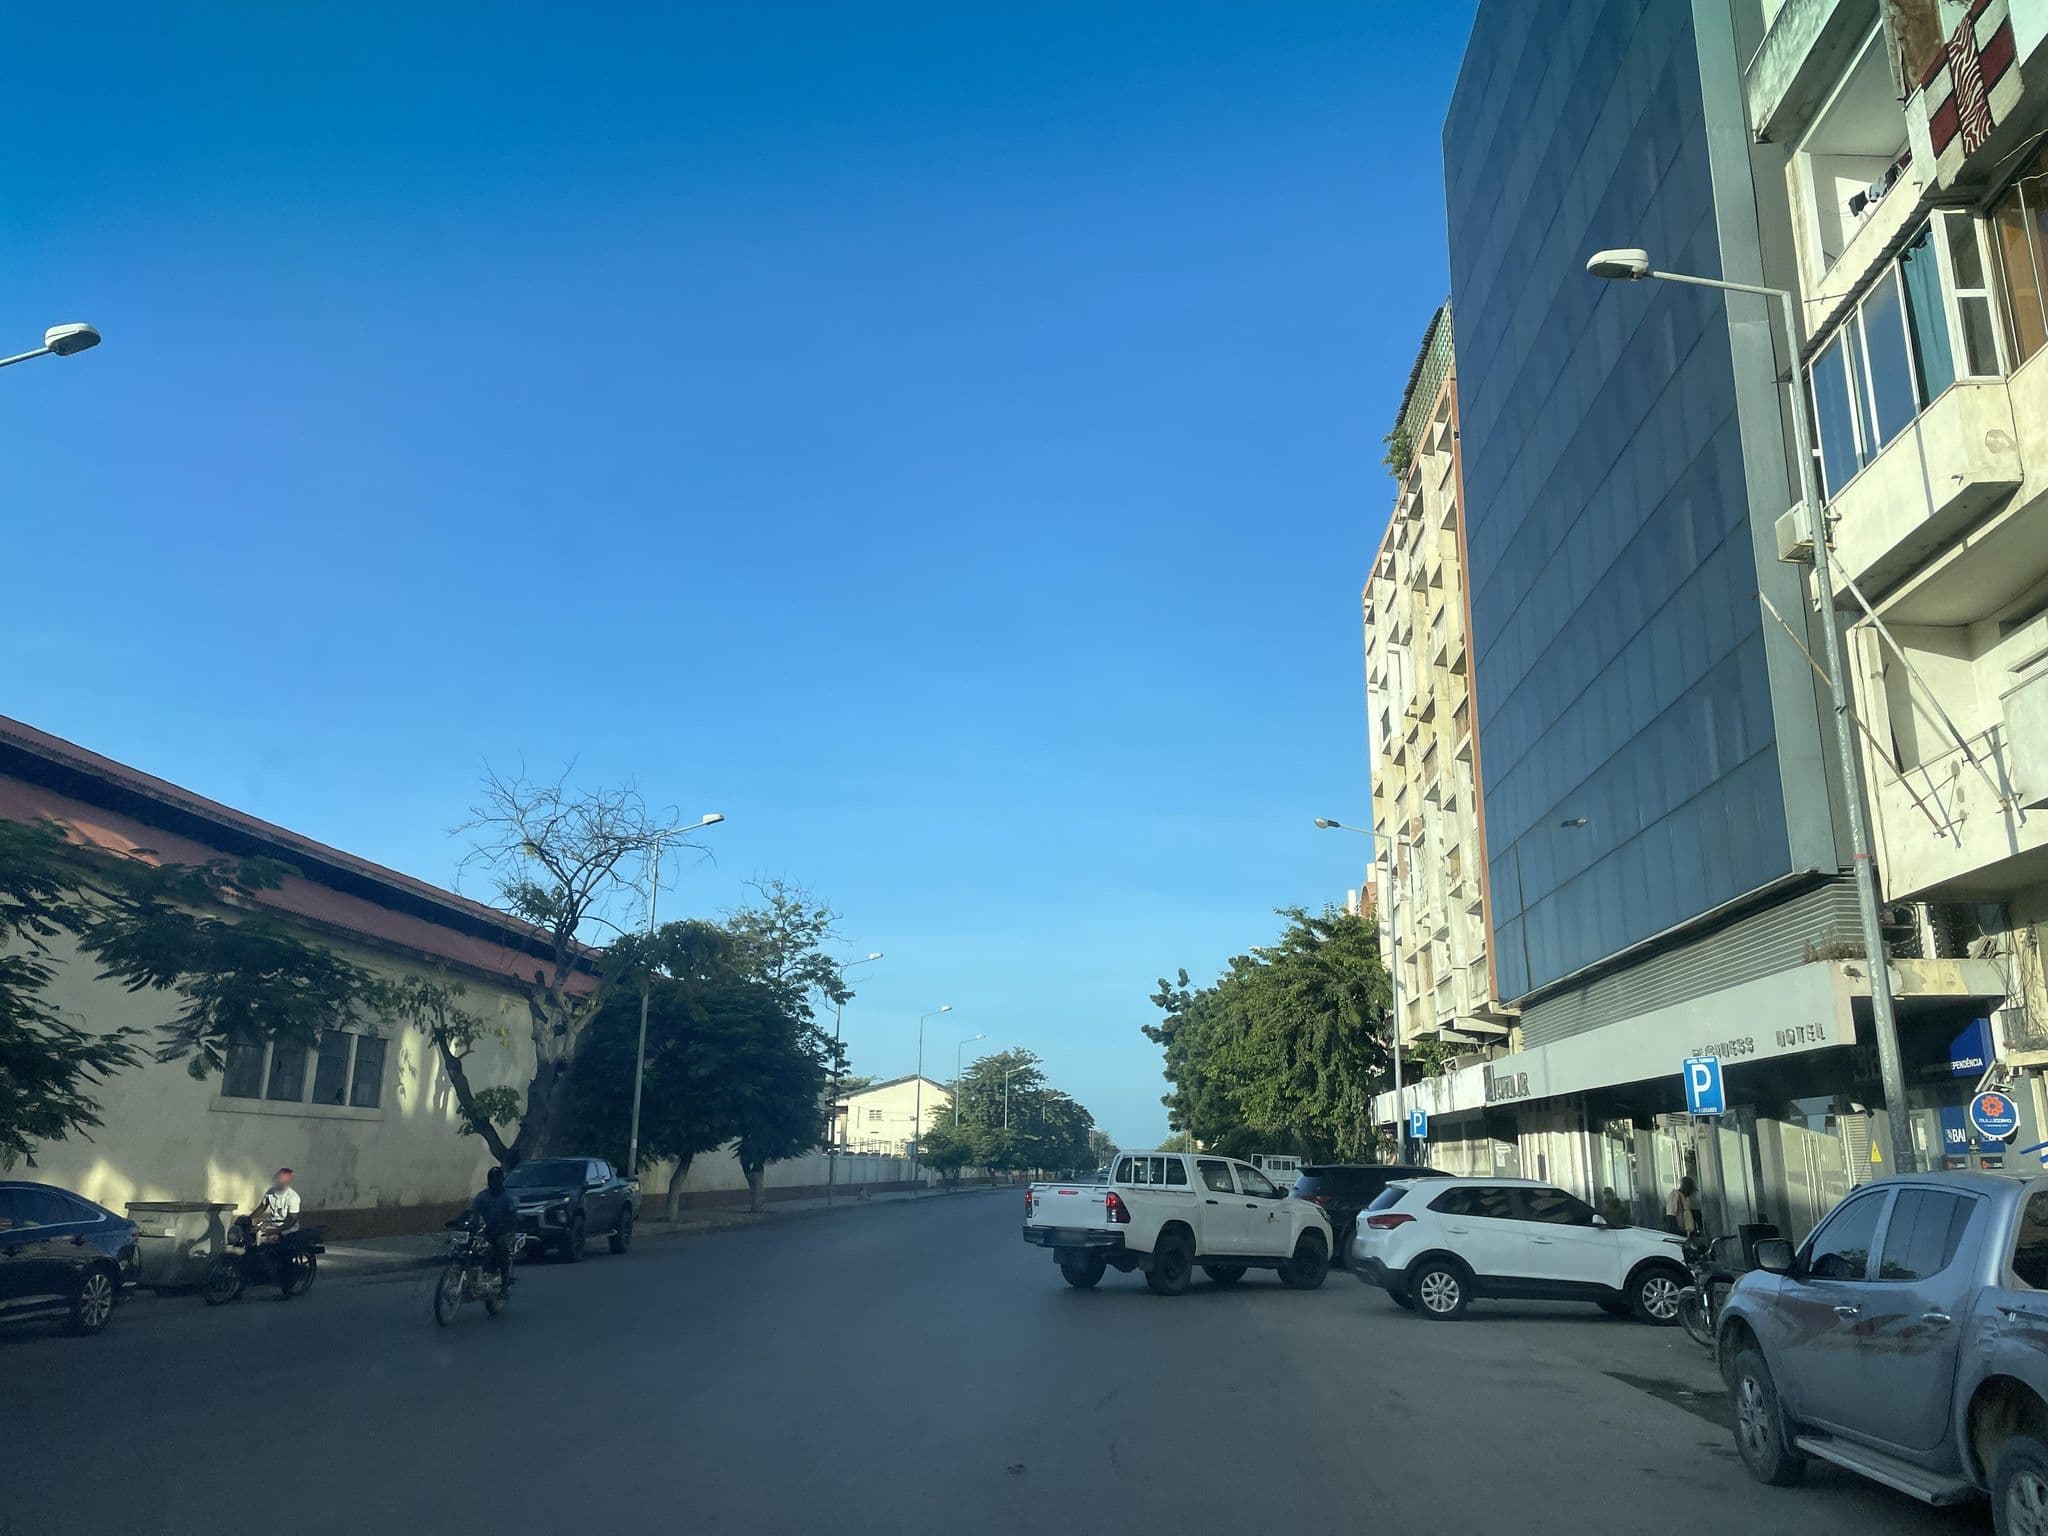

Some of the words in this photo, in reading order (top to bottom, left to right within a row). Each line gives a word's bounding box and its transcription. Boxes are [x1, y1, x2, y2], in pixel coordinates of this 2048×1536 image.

[1691, 1064, 1712, 1108] P
[1413, 1112, 1423, 1134] P
[1952, 1128, 1967, 1143] BAI
